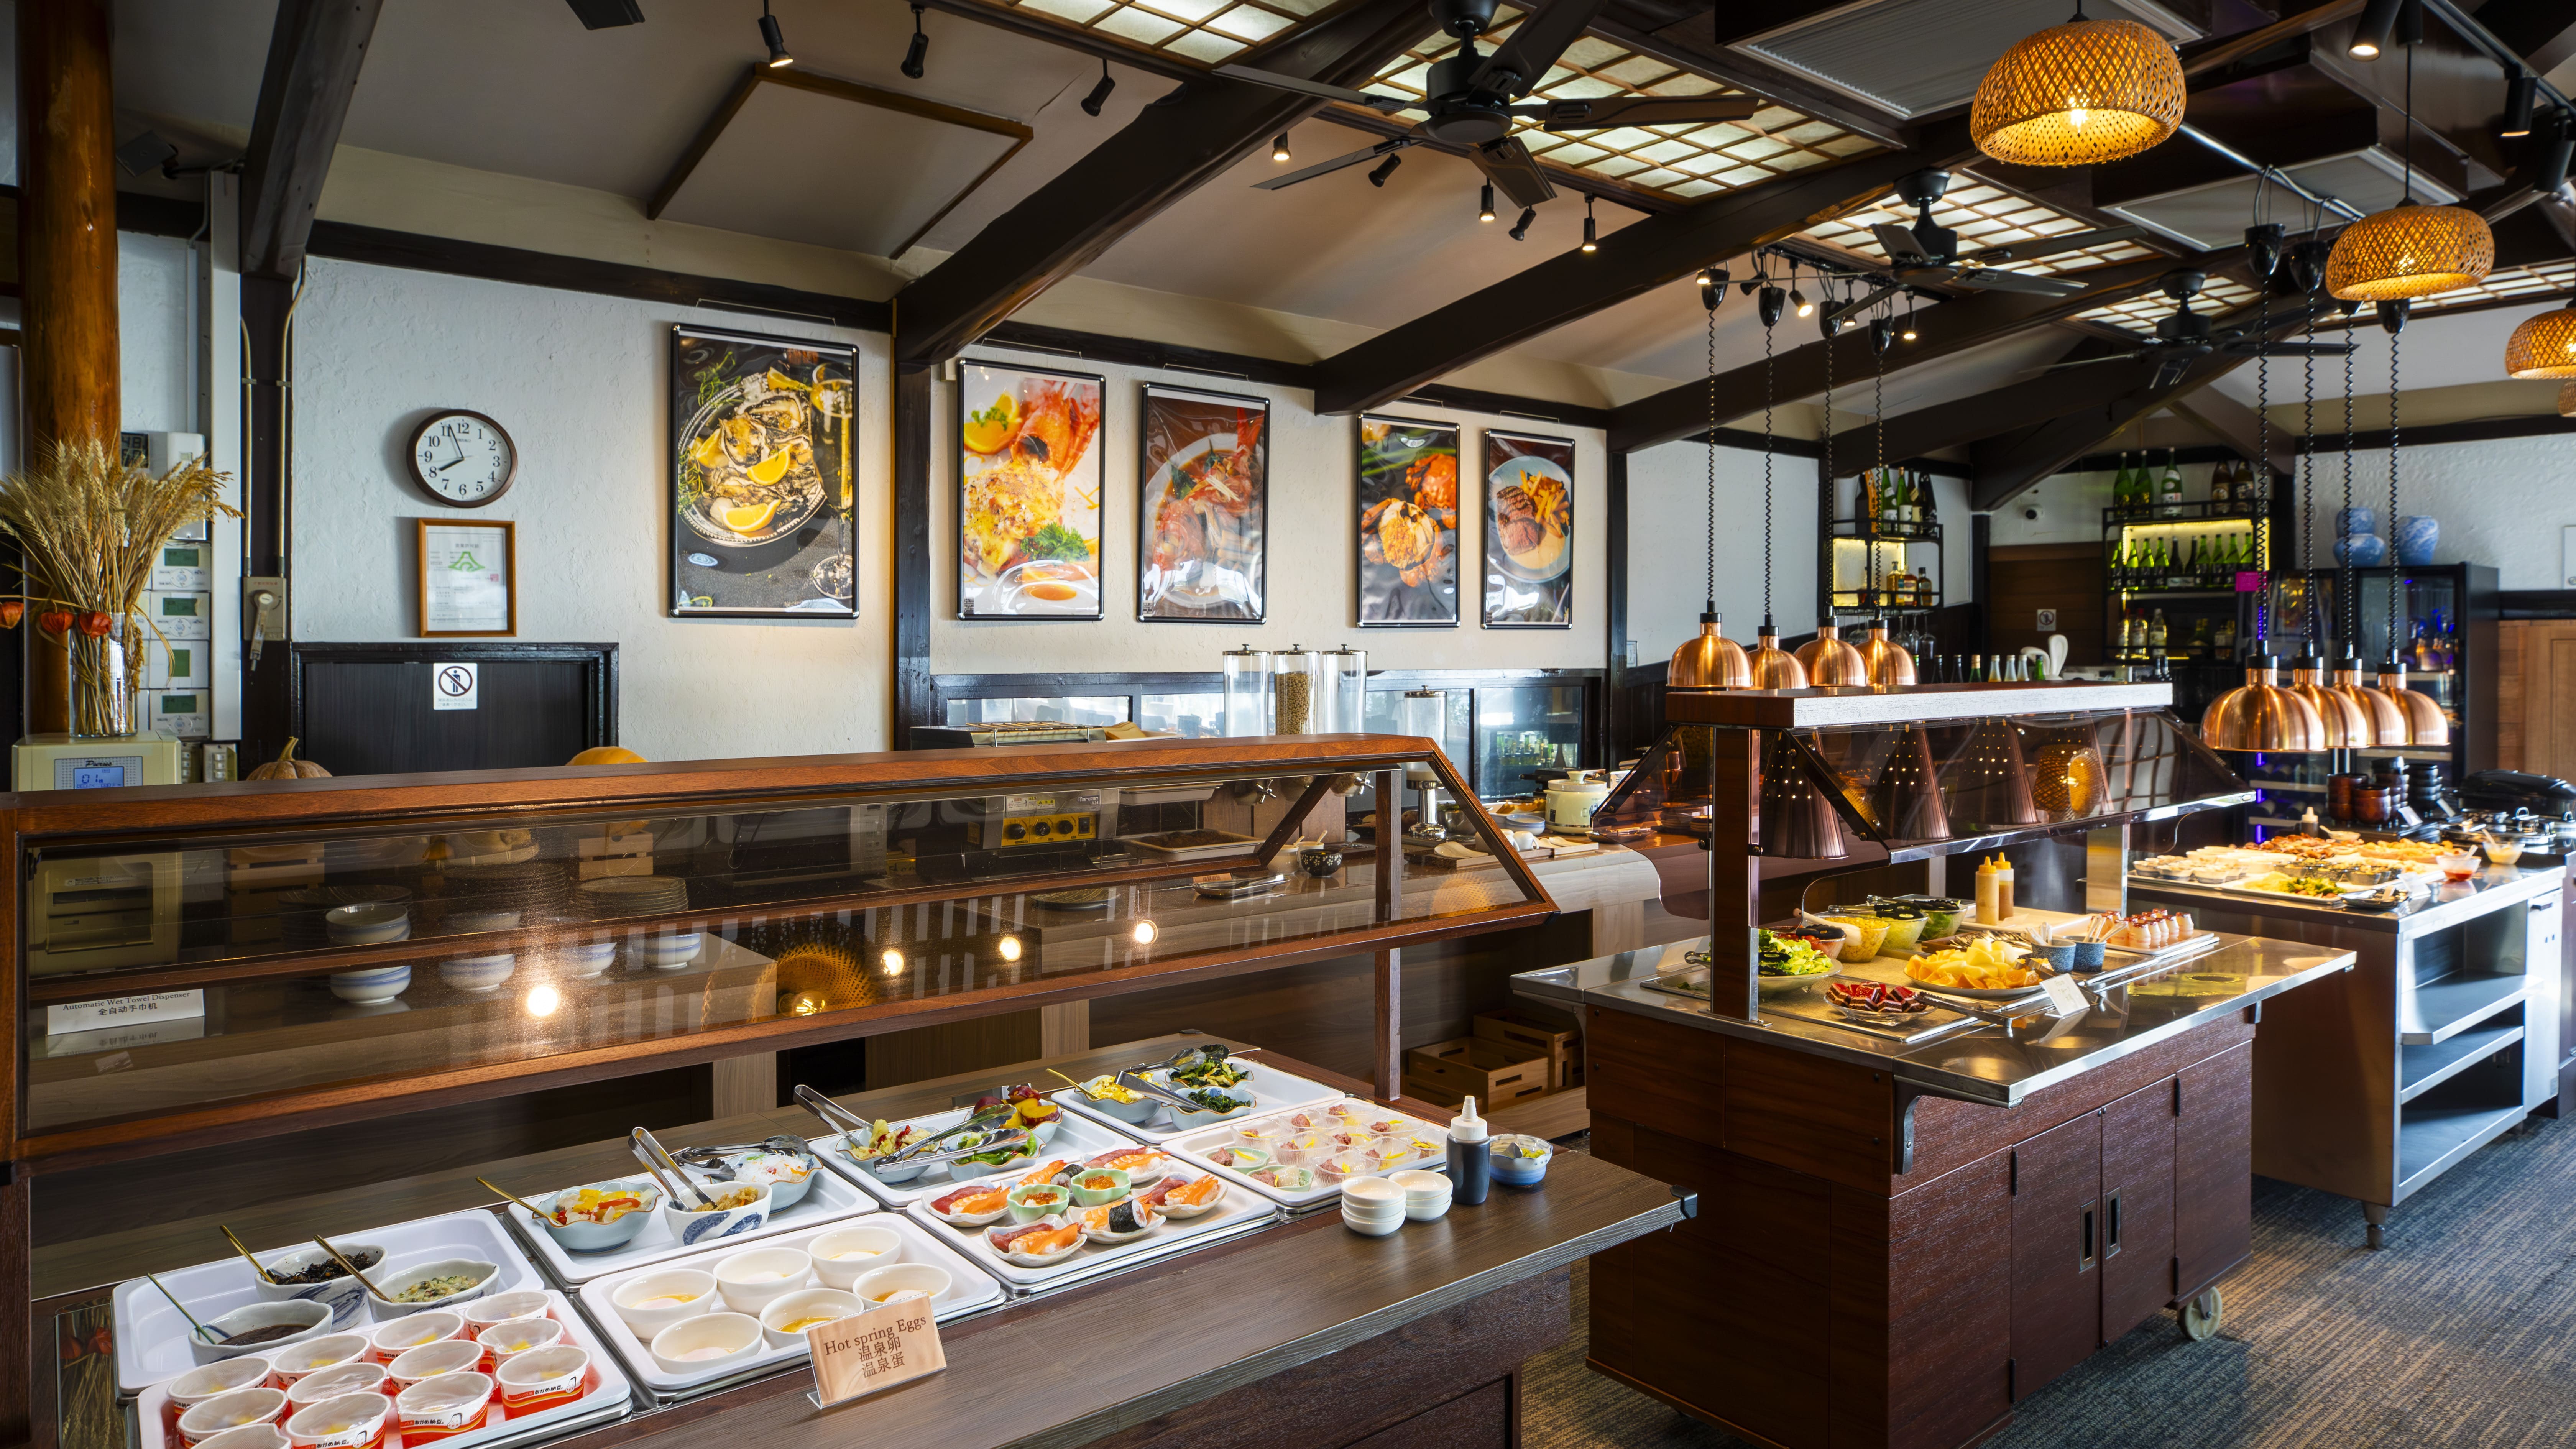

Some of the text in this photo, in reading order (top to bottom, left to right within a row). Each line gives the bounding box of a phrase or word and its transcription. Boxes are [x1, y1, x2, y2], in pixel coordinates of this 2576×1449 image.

[442, 425, 450, 436] 11
[457, 423, 469, 434] 12
[478, 429, 482, 439] 1
[428, 435, 440, 447] 10
[489, 440, 496, 450] 2
[424, 451, 432, 462] 9
[493, 456, 500, 467] 3
[429, 467, 437, 478] 8
[488, 471, 496, 482] 4
[442, 479, 449, 490] 7
[459, 484, 467, 495] 6
[476, 481, 483, 492] 5
[63, 1001, 105, 1011] Automatic
[125, 996, 150, 1004] Towel
[152, 992, 190, 1001] Dispenser
[98, 1002, 158, 1016] 全自动手巾机
[823, 1316, 927, 1355] Hot spring Eggs
[858, 1336, 901, 1362] 温泉卵
[862, 1352, 905, 1378] 温泉蛋
